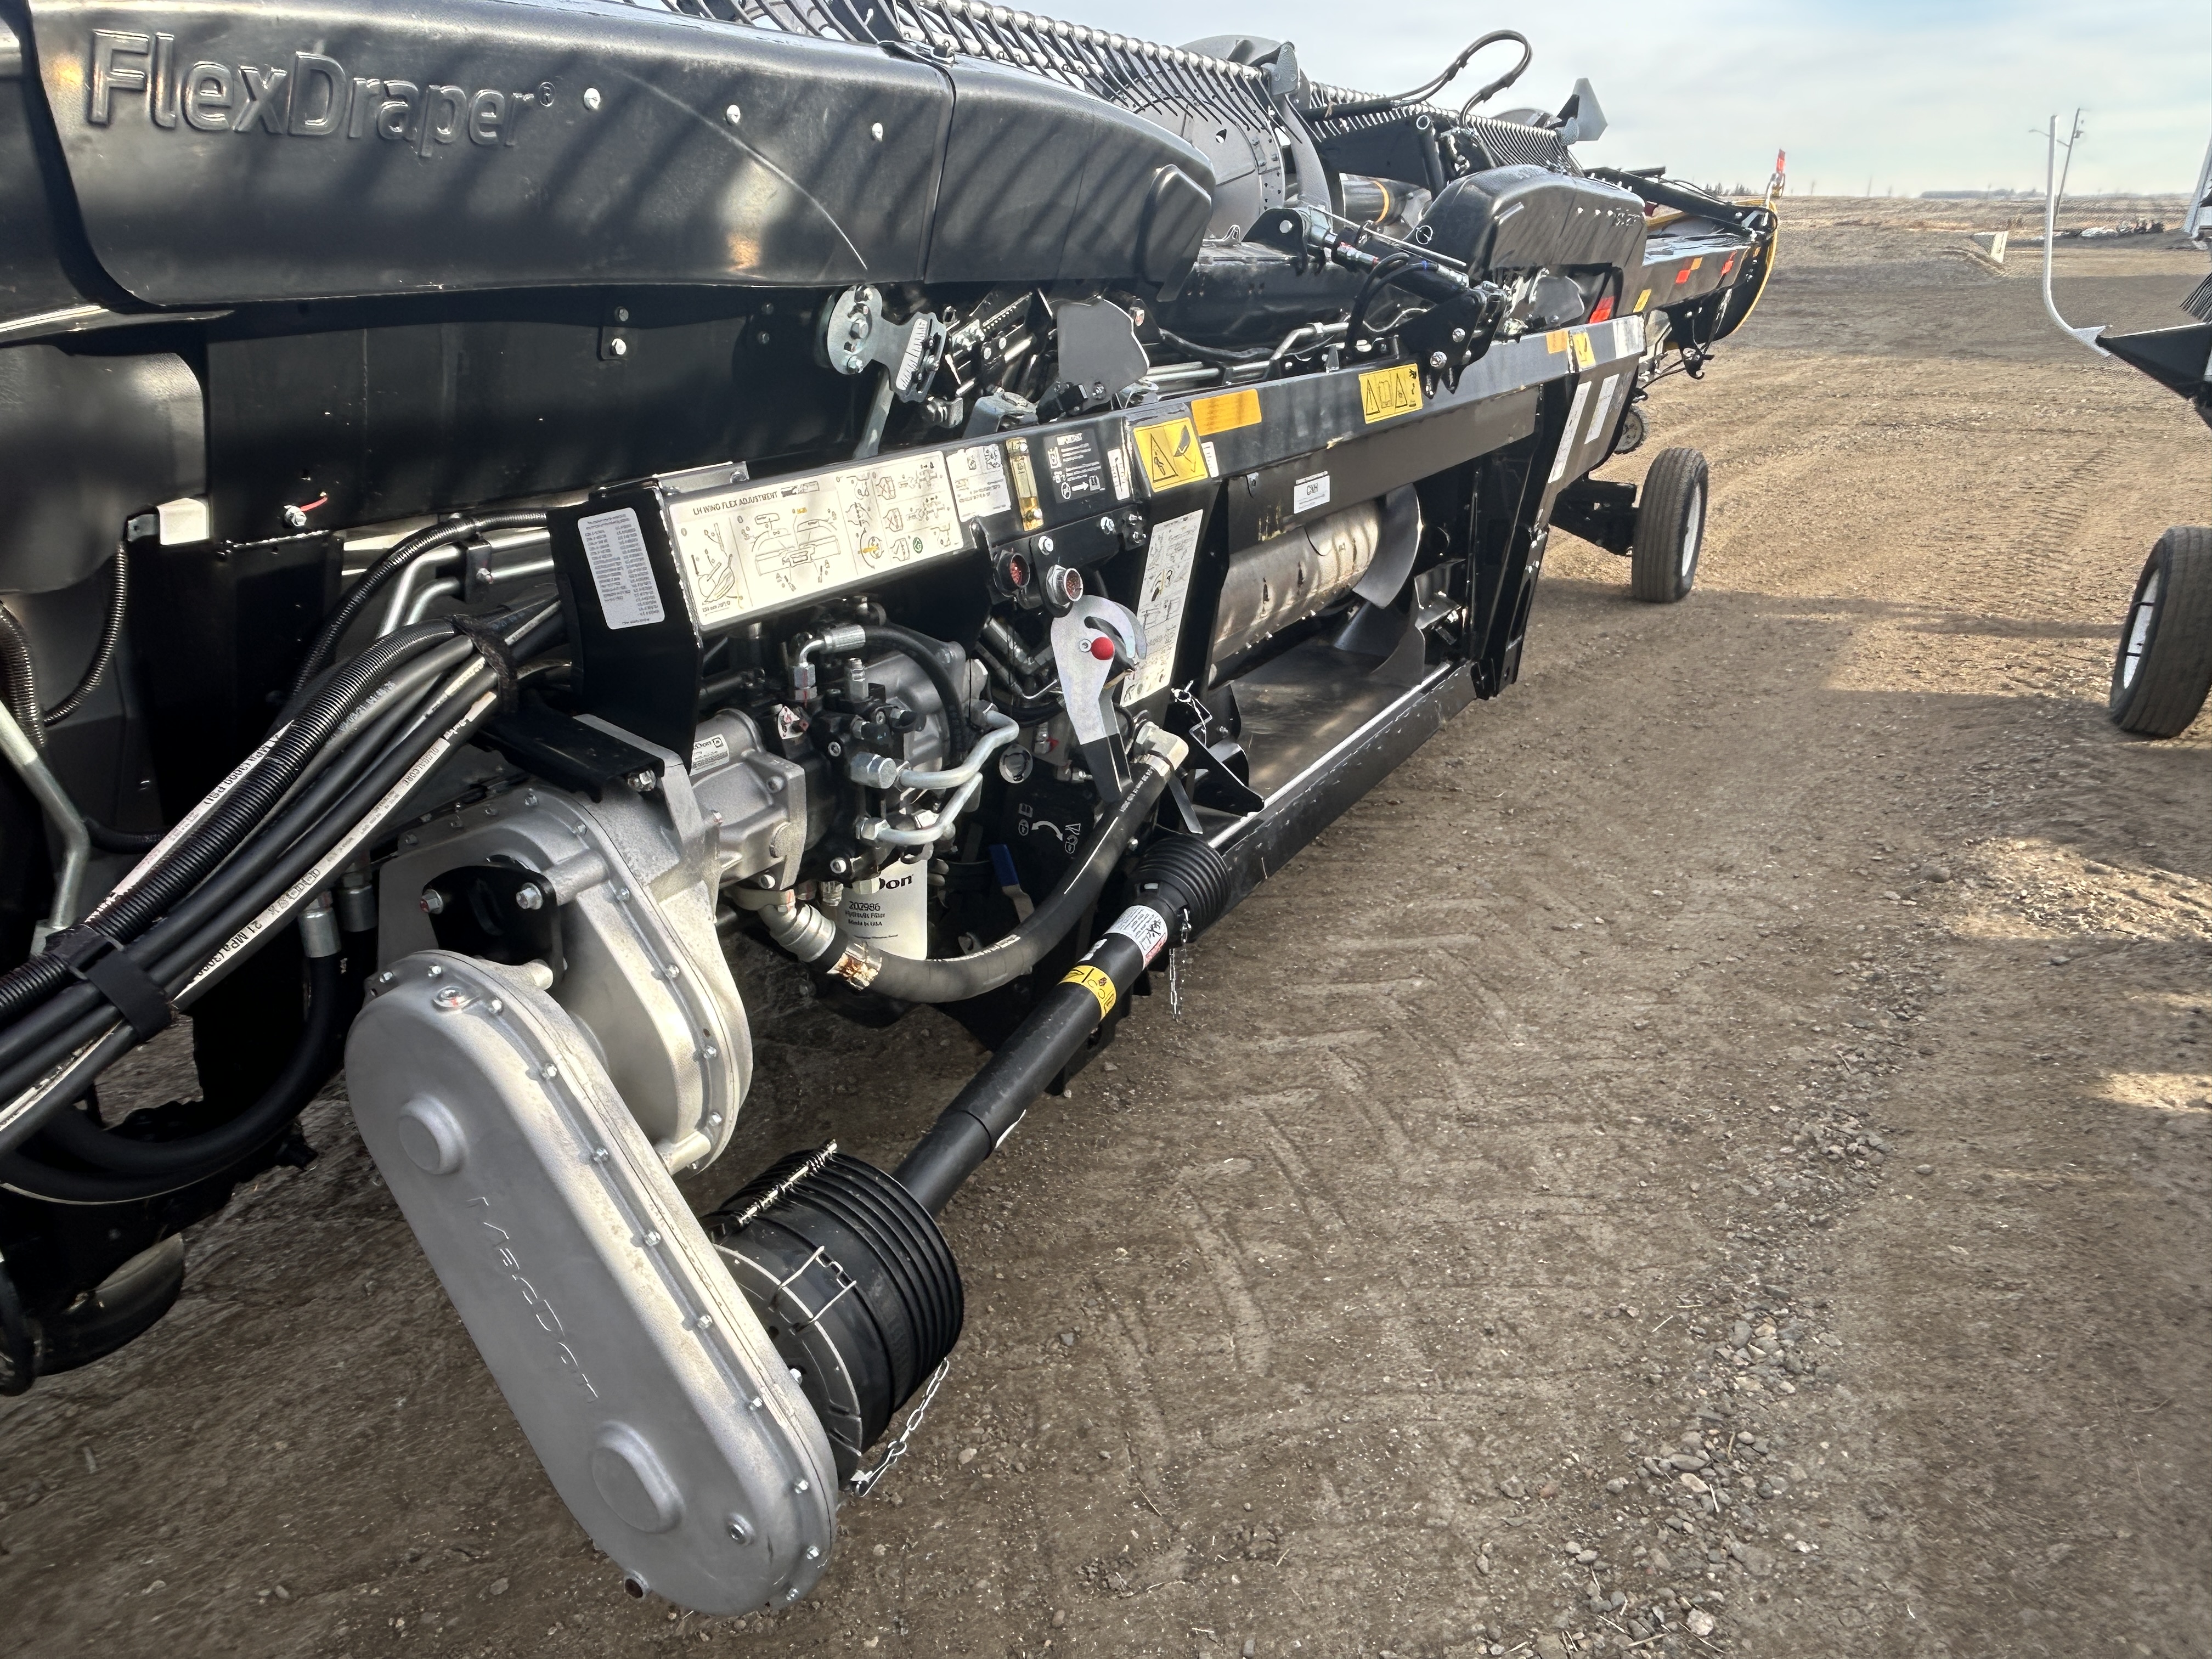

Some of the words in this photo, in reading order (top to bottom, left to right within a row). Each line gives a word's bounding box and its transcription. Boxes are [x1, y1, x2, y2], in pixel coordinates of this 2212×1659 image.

[721, 500, 738, 511] FLEX
[849, 901, 881, 911] 202986
[245, 918, 263, 935] 21
[221, 929, 249, 956] MPa
